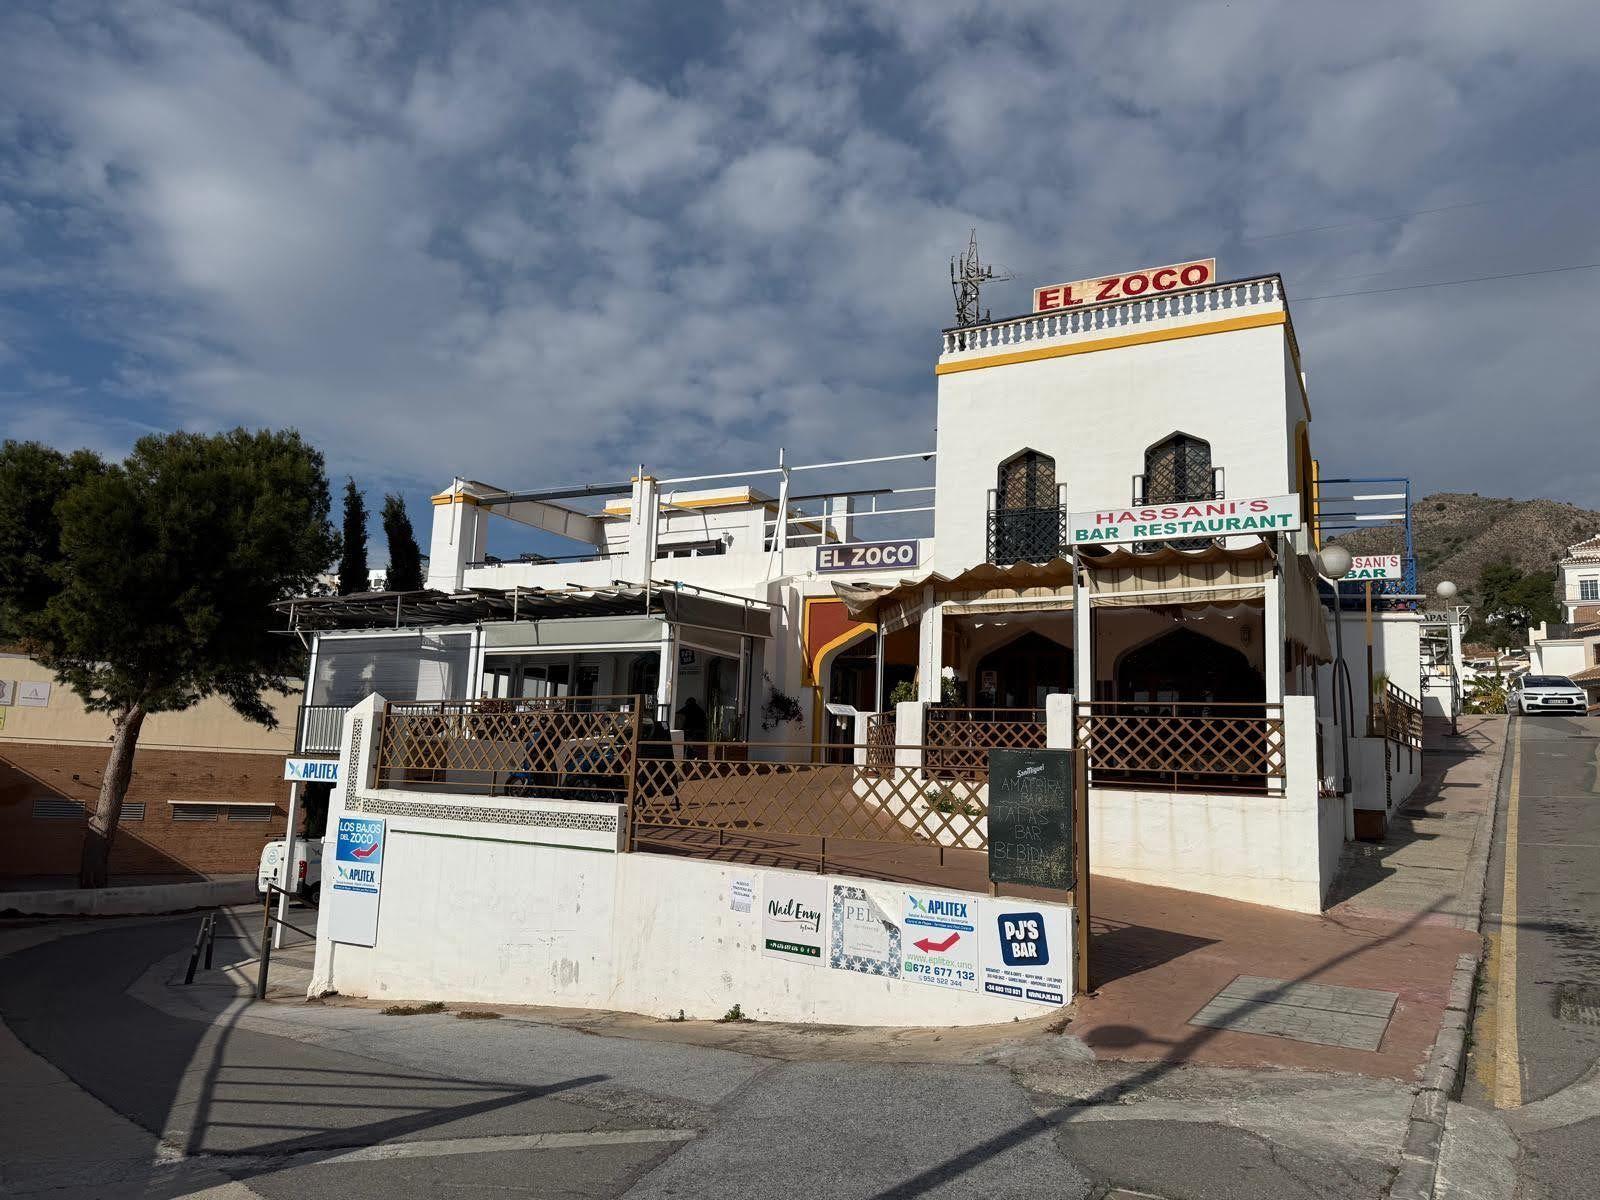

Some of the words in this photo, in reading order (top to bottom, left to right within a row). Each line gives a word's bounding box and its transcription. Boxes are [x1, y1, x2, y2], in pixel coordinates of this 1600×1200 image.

[1039, 286, 1084, 311] EL
[1095, 264, 1209, 301] ZOCO
[1075, 527, 1119, 541] BAR
[1133, 513, 1292, 537] RESTAURANT
[819, 550, 844, 567] EL
[851, 545, 913, 565] ZOCO
[302, 763, 338, 779] APLITEX
[340, 821, 355, 832] LOS
[355, 822, 382, 834] BAJOS
[1015, 825, 1042, 840] BAR
[340, 833, 350, 841] DEL
[349, 832, 374, 844] ZOCO
[349, 868, 375, 883] APLITEX
[768, 899, 795, 916] Nail
[795, 903, 821, 933] Envy
[847, 905, 882, 924] PEL
[928, 899, 968, 918] APLITEX
[1004, 919, 1039, 940] PJ'S
[1011, 941, 1038, 958] BAR
[913, 963, 931, 975] 672
[934, 966, 952, 977] 677
[956, 970, 975, 981] 132
[923, 975, 935, 983] 952
[936, 977, 949, 985] 522
